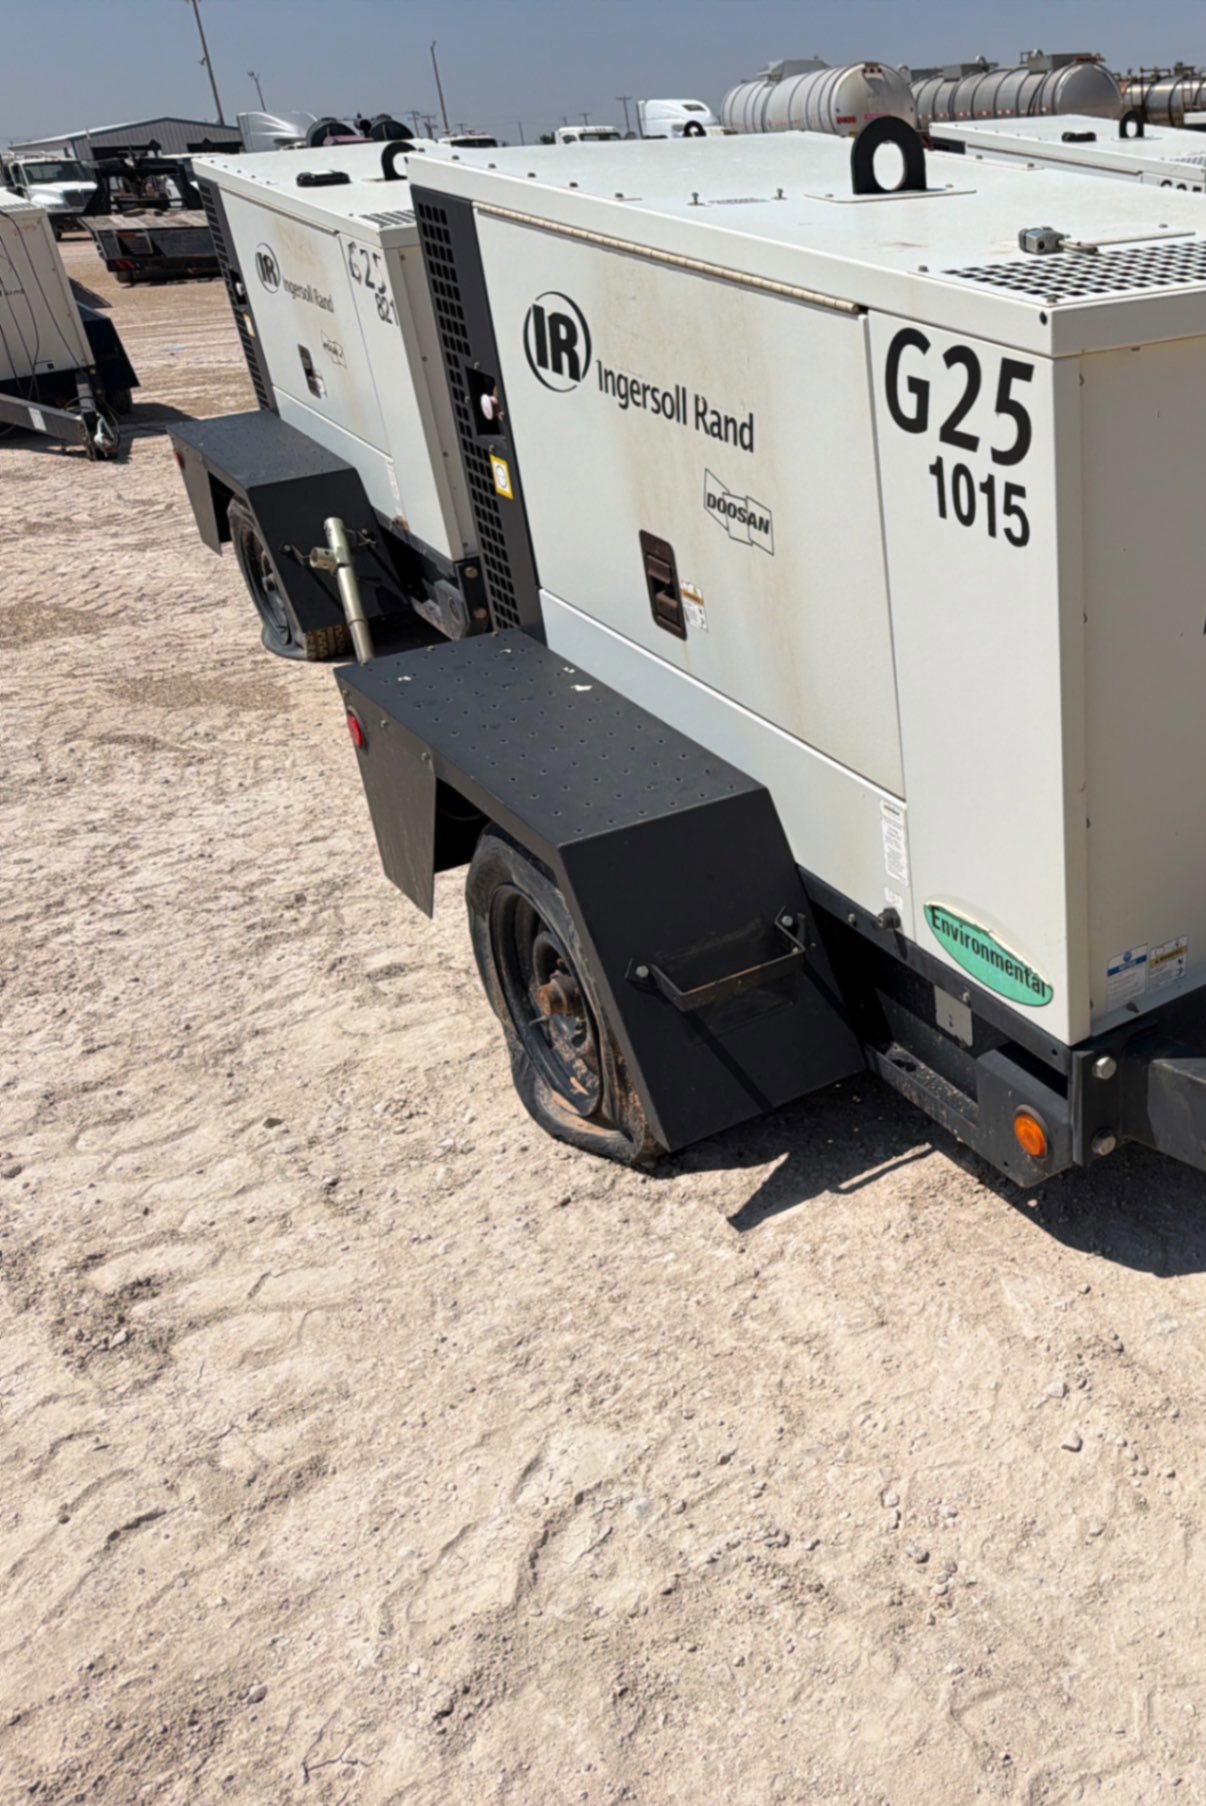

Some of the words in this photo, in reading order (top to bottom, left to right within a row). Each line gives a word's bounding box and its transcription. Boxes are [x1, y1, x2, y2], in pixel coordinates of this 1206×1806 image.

[256, 251, 279, 287] IR
[532, 303, 582, 383] IR
[596, 359, 687, 427] Ingersoll
[694, 393, 754, 454] Rand
[885, 327, 1035, 467] G25
[706, 491, 770, 535] DOOSAN
[929, 455, 1031, 548] 1015
[929, 904, 1047, 998] Environmental
